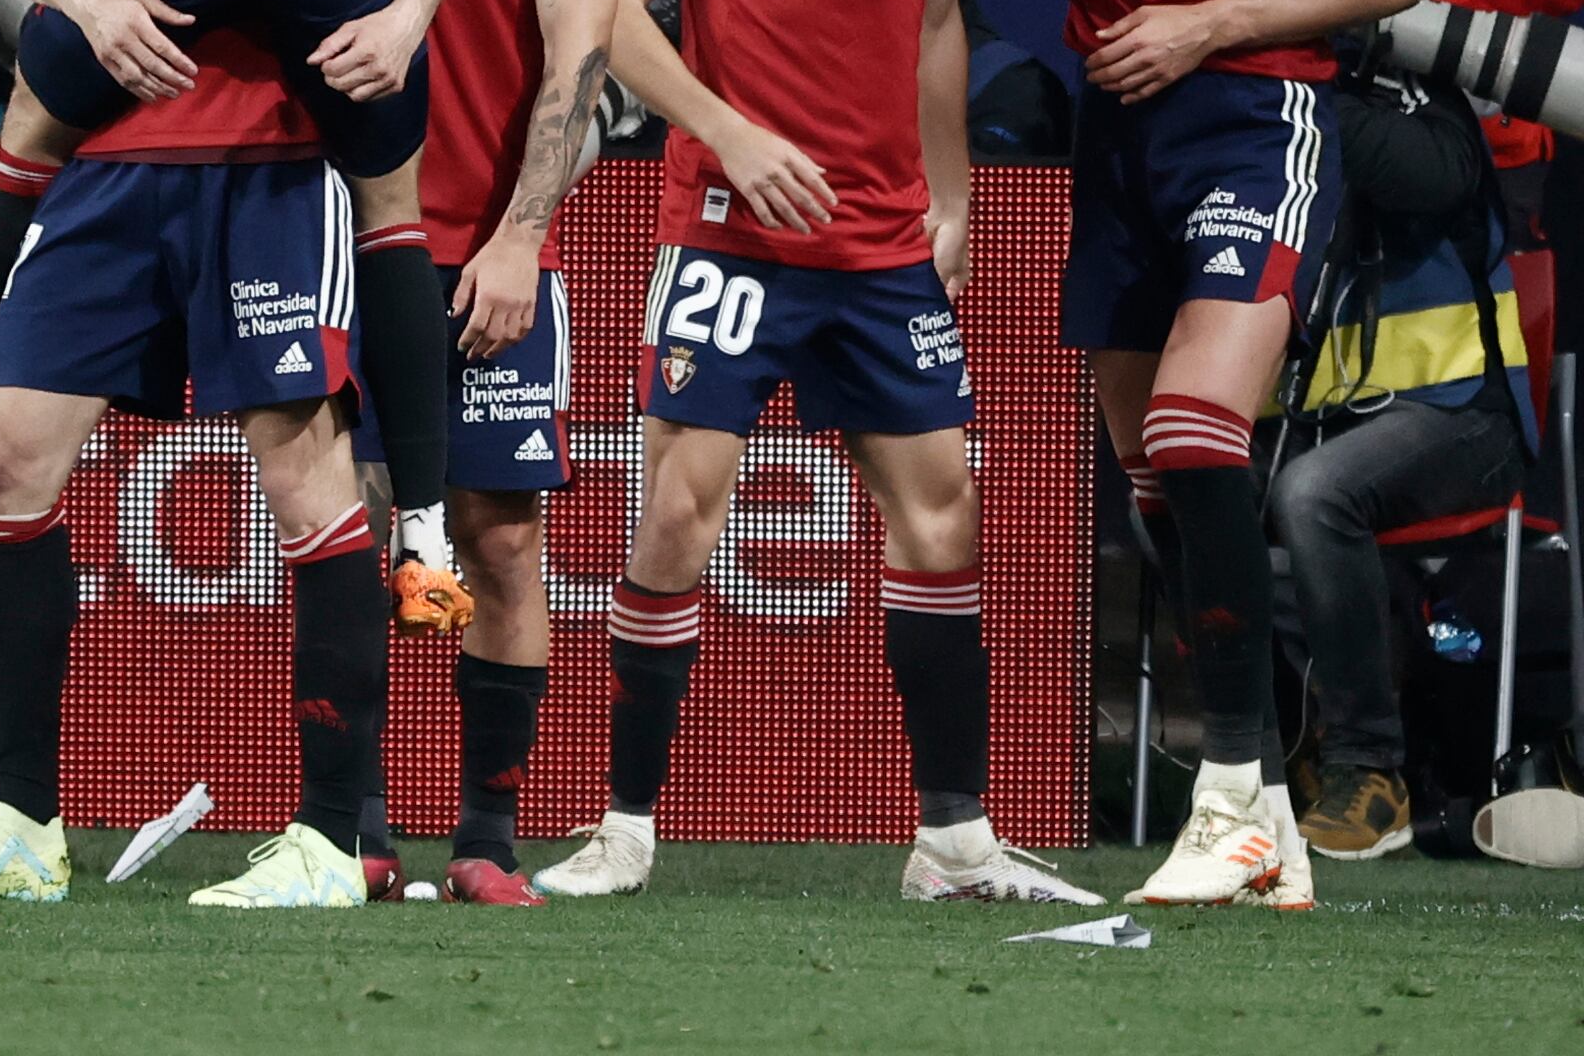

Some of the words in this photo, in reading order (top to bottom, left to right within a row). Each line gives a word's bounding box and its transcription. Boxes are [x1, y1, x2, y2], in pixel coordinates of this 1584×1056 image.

[1198, 220, 1263, 243] Navarra
[1202, 263, 1246, 277] adidas
[233, 291, 316, 320] Universidad
[665, 259, 765, 356] 20
[237, 320, 251, 339] de
[251, 314, 315, 336] Navarra
[275, 361, 313, 374] adidas
[916, 351, 936, 371] de
[462, 382, 553, 405] Universidad
[462, 405, 485, 424] de
[489, 403, 552, 422] Navarra
[513, 449, 554, 461] adidas
